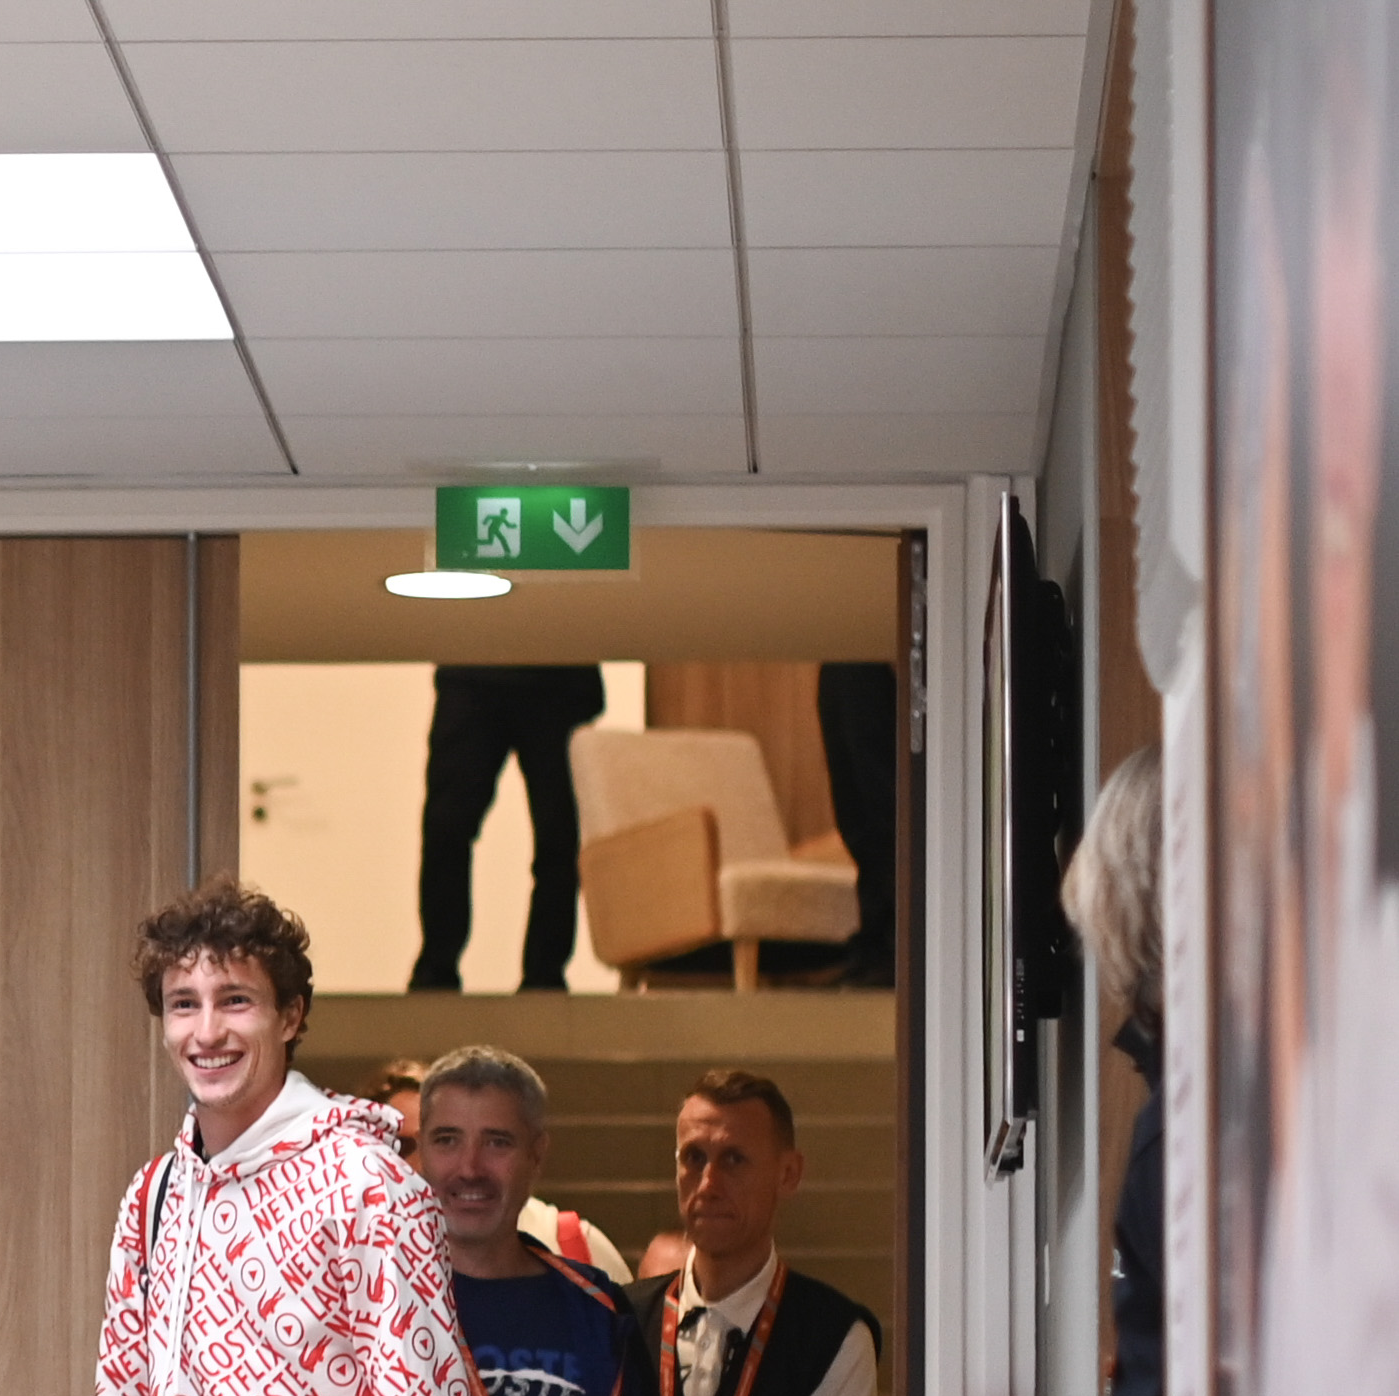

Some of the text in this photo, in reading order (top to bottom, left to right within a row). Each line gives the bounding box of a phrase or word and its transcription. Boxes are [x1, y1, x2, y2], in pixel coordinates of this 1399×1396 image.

[242, 1138, 347, 1210] LACOSTE
[253, 1159, 348, 1238] NETFLIX
[267, 1184, 357, 1266] LACOSTE
